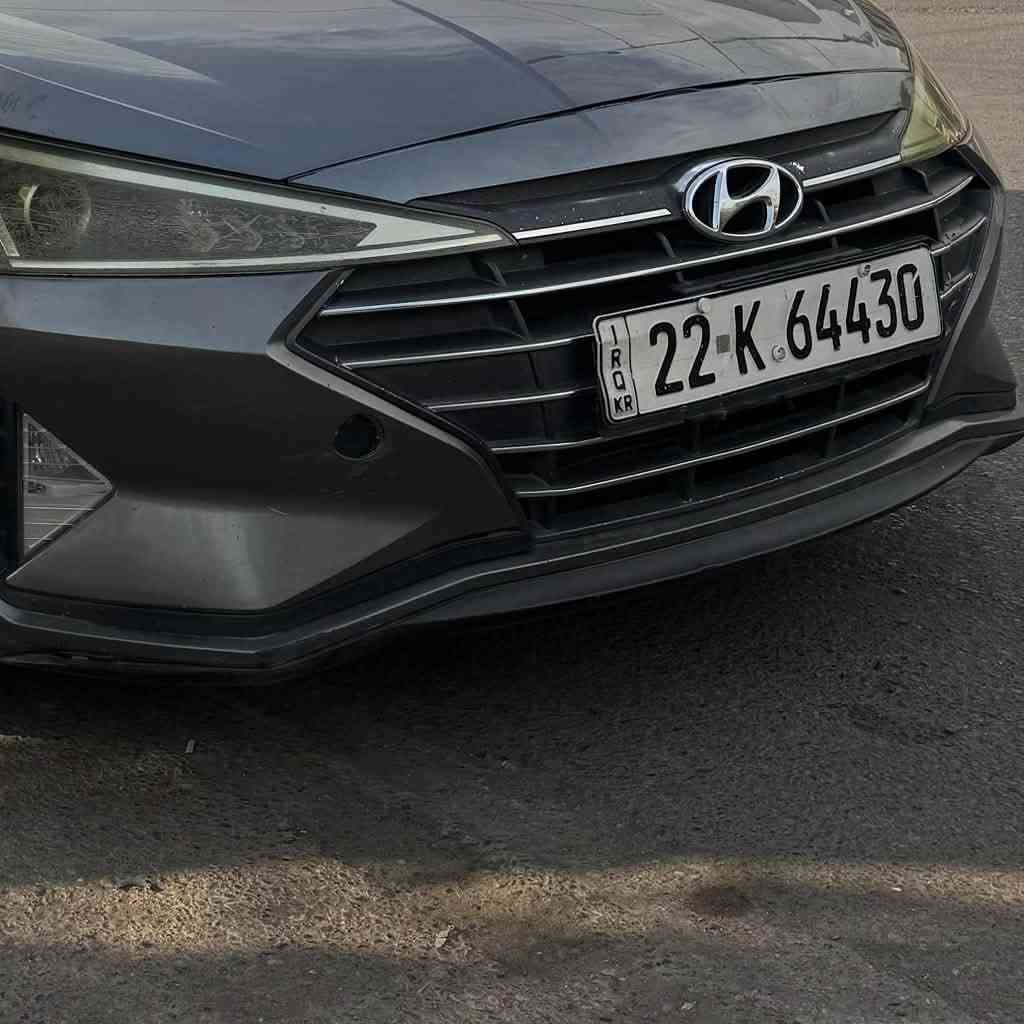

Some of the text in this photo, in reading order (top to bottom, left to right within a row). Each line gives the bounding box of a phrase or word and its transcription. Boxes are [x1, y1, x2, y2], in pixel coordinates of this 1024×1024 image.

[609, 324, 626, 390] IRQ
[649, 263, 925, 397] 22 K 64430
[613, 394, 634, 415] KR
